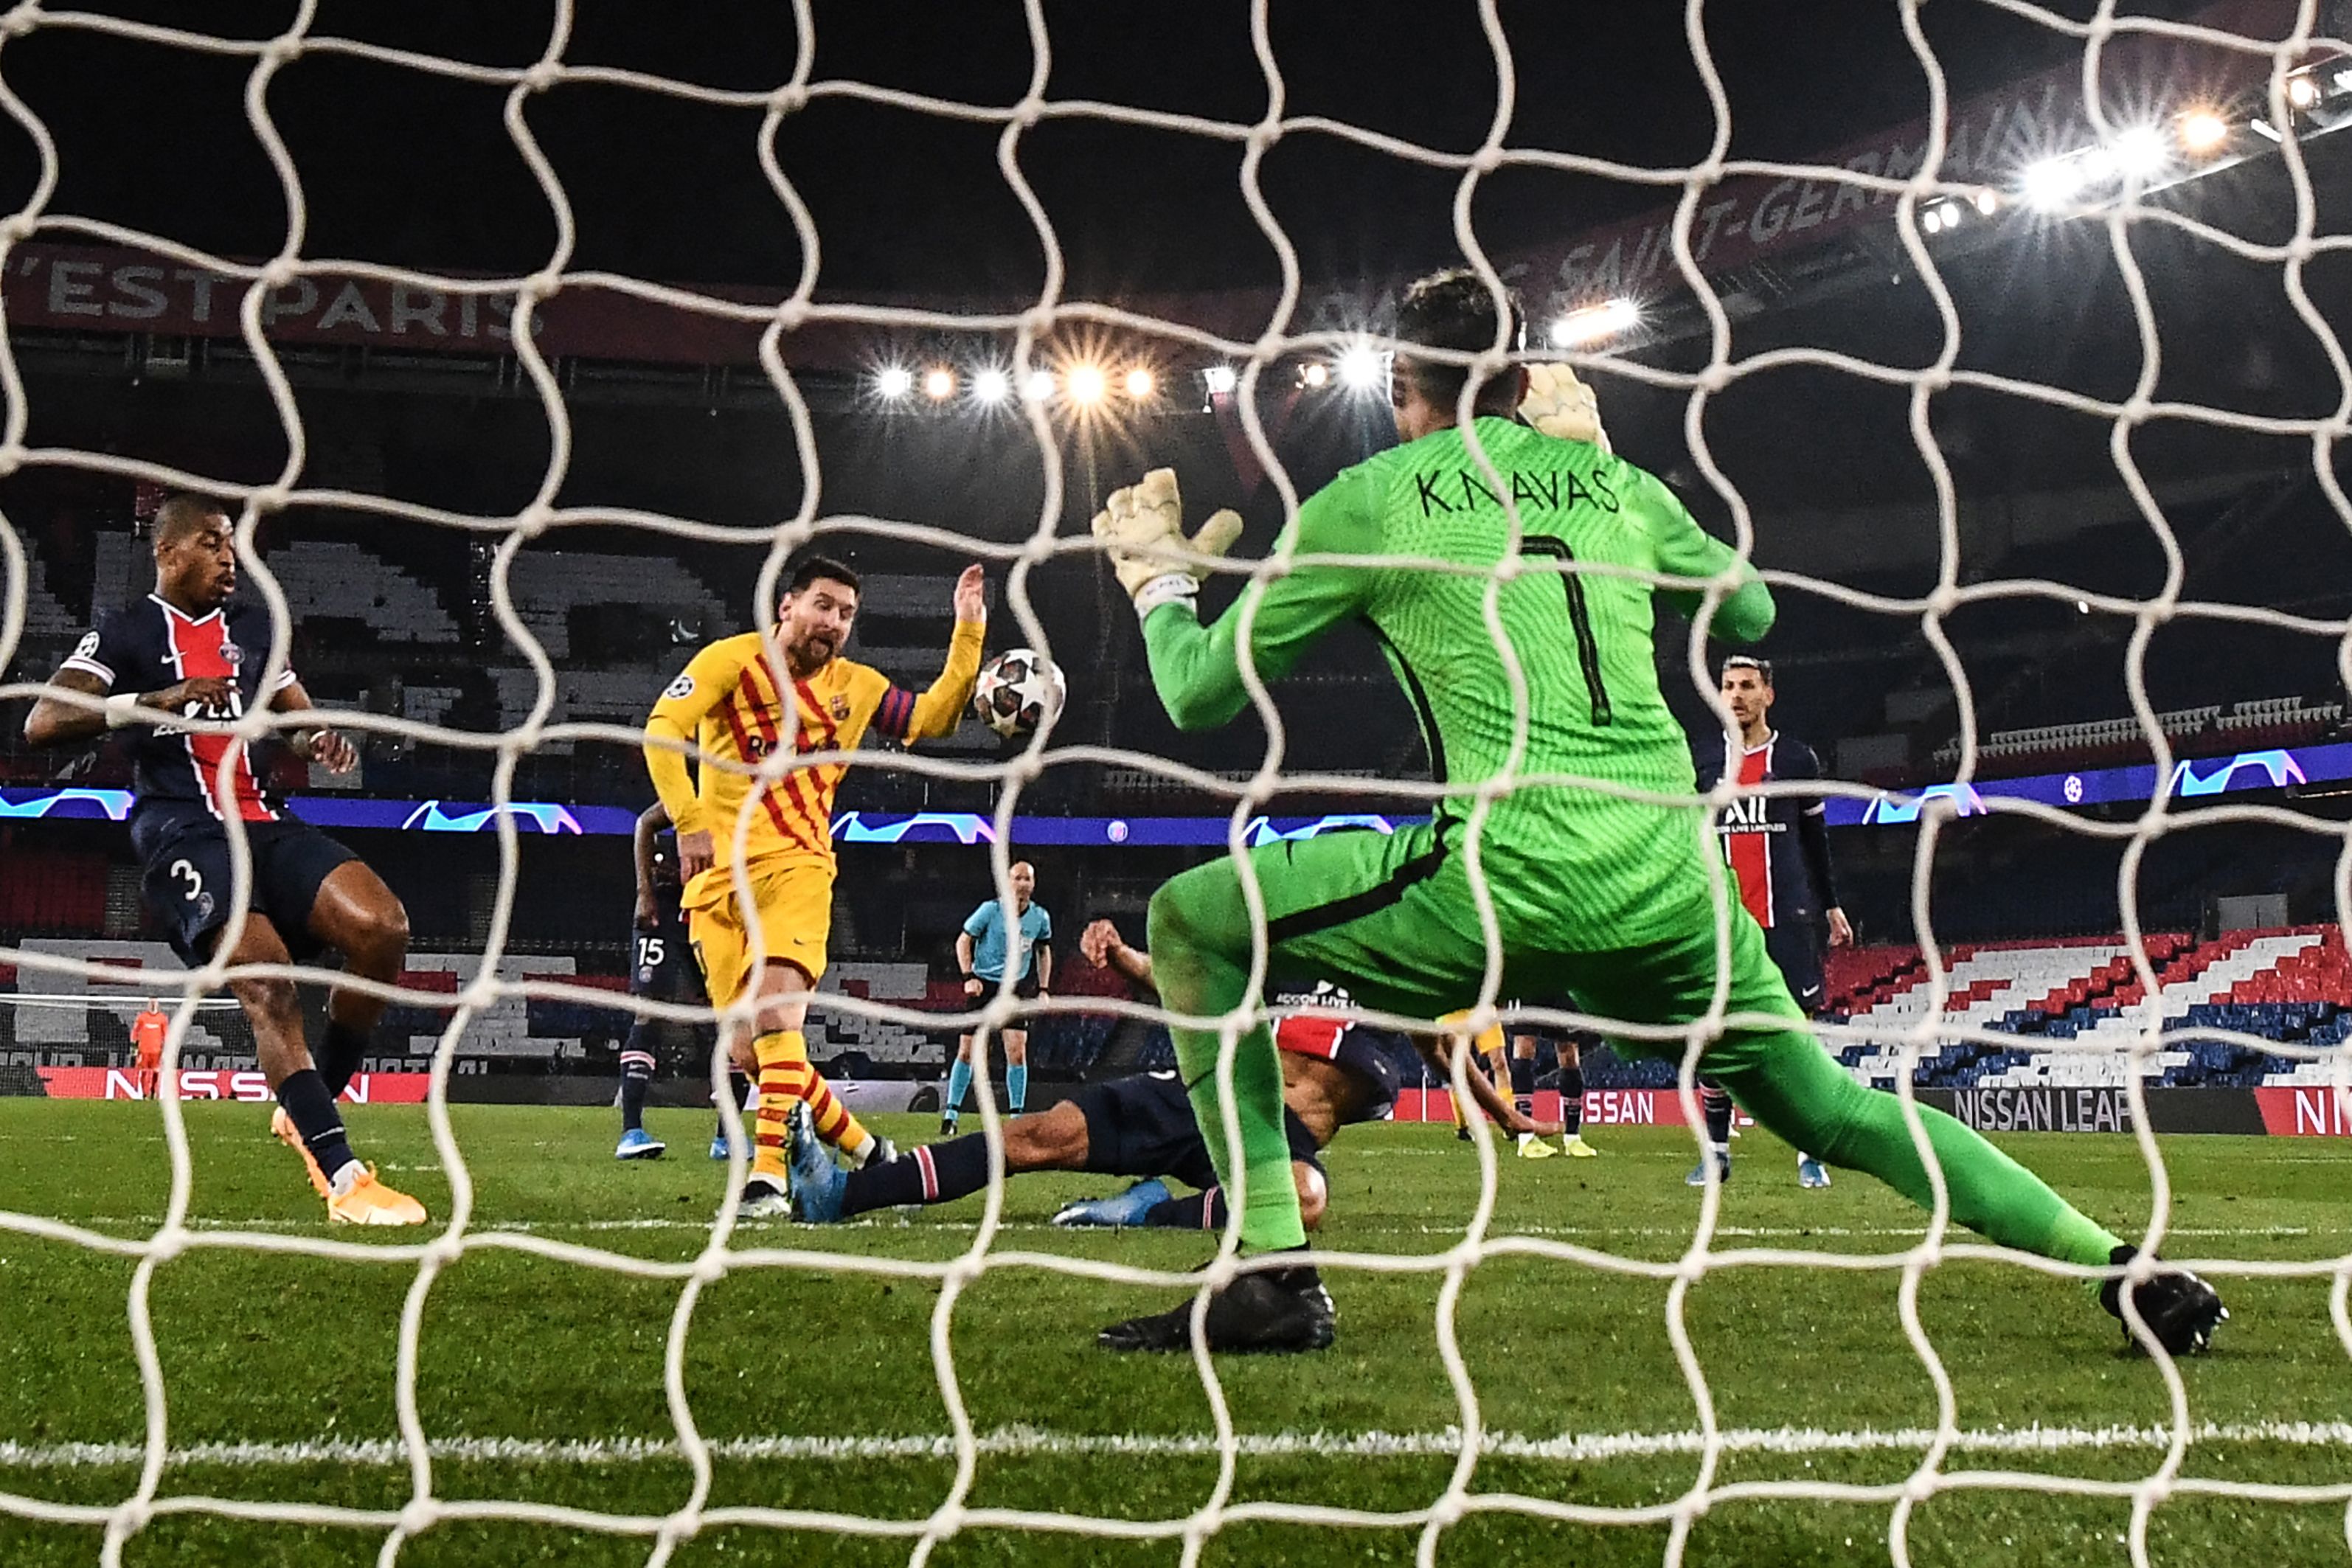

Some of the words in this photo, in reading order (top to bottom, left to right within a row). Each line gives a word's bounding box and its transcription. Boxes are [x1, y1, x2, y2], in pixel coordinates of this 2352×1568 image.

[2, 256, 226, 322] 'EST
[1518, 534, 1612, 726] 1
[170, 858, 202, 901] 3
[638, 937, 665, 966] 15
[105, 1069, 370, 1103] NSSN
[1954, 1089, 2053, 1131] NISSAN
[2061, 1089, 2131, 1132] LEAF
[2295, 1089, 2352, 1135] NI
